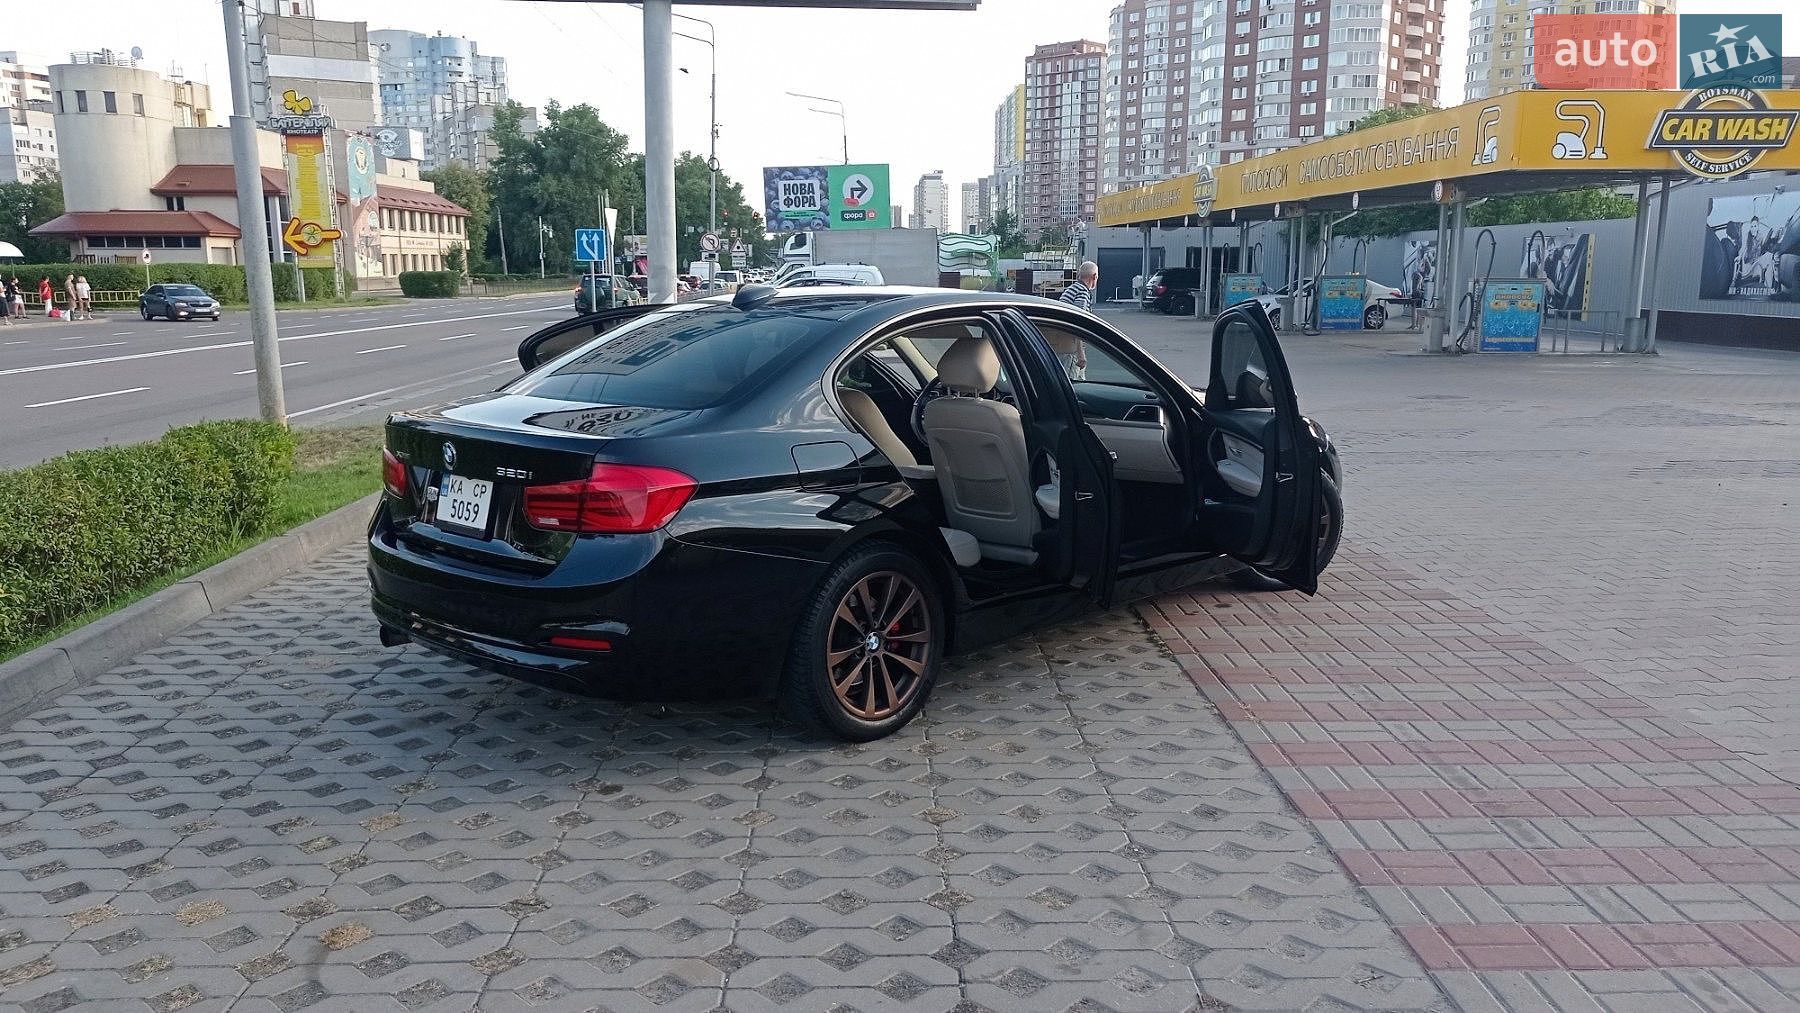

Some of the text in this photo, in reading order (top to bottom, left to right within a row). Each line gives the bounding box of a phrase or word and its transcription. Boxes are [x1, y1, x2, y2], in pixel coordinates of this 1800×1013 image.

[1698, 87, 1755, 103] BOTSMAN
[1661, 118, 1789, 141] CAR WASH
[1241, 126, 1460, 194] ПИЛОСОСИ САМООБСЛУГОВУВАННЯ
[1685, 152, 1753, 173] SELF SERVICE
[783, 183, 815, 196] НОВА
[783, 195, 817, 209] ФОРА
[843, 212, 863, 220] фора
[449, 478, 463, 494] KA
[473, 483, 487, 498] CP
[450, 499, 479, 523] 5059
